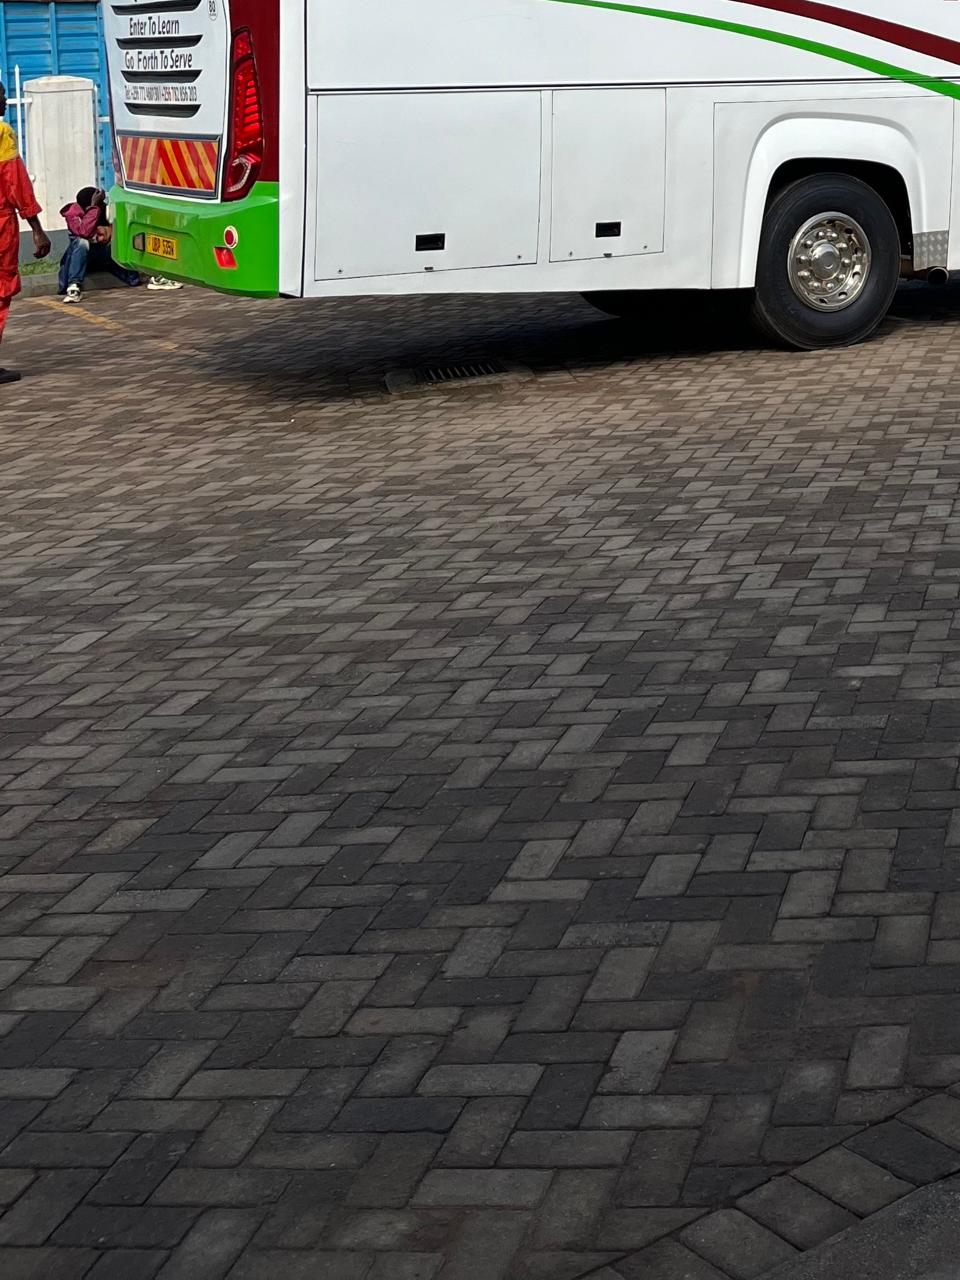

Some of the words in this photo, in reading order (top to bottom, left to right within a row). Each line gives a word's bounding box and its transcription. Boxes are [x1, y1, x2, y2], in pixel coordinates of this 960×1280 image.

[129, 17, 147, 36] Enter
[148, 16, 156, 35] To
[157, 15, 180, 35] Learn
[125, 51, 135, 70] Go
[137, 50, 159, 70] Forth
[160, 50, 168, 69] To
[170, 49, 193, 69] Serve
